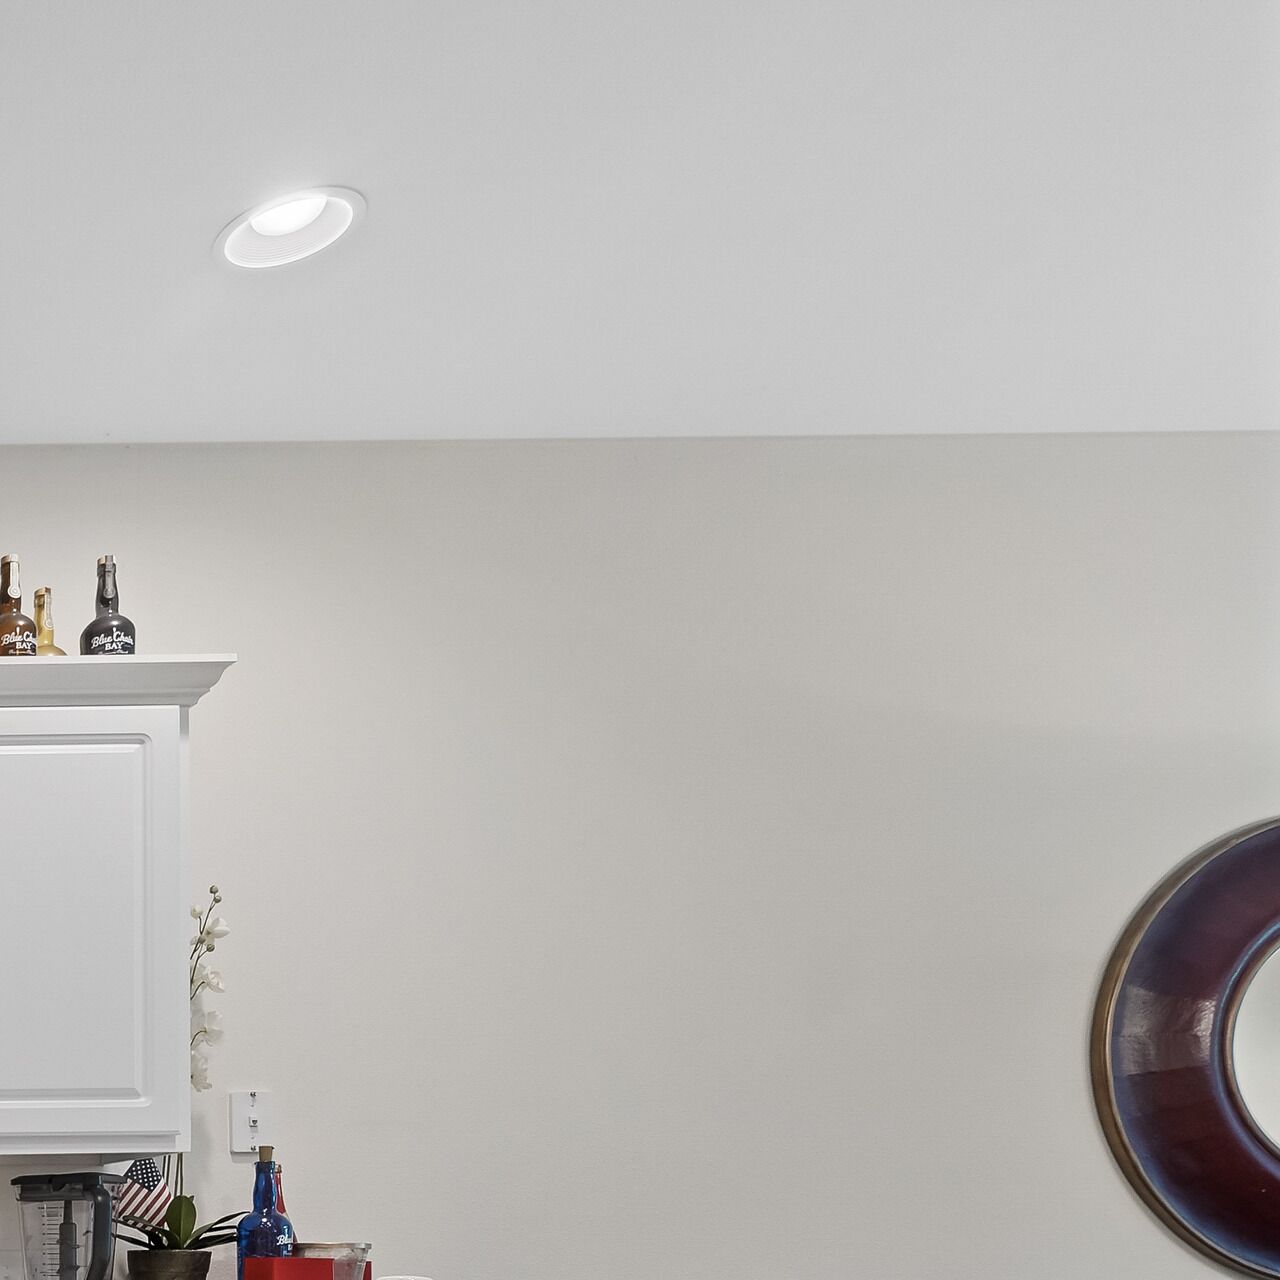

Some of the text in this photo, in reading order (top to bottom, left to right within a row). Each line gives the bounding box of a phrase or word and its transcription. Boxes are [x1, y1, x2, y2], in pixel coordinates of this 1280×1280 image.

[1, 631, 22, 646] Blue
[91, 631, 134, 648] Blue Chair
[105, 642, 124, 650] BAY
